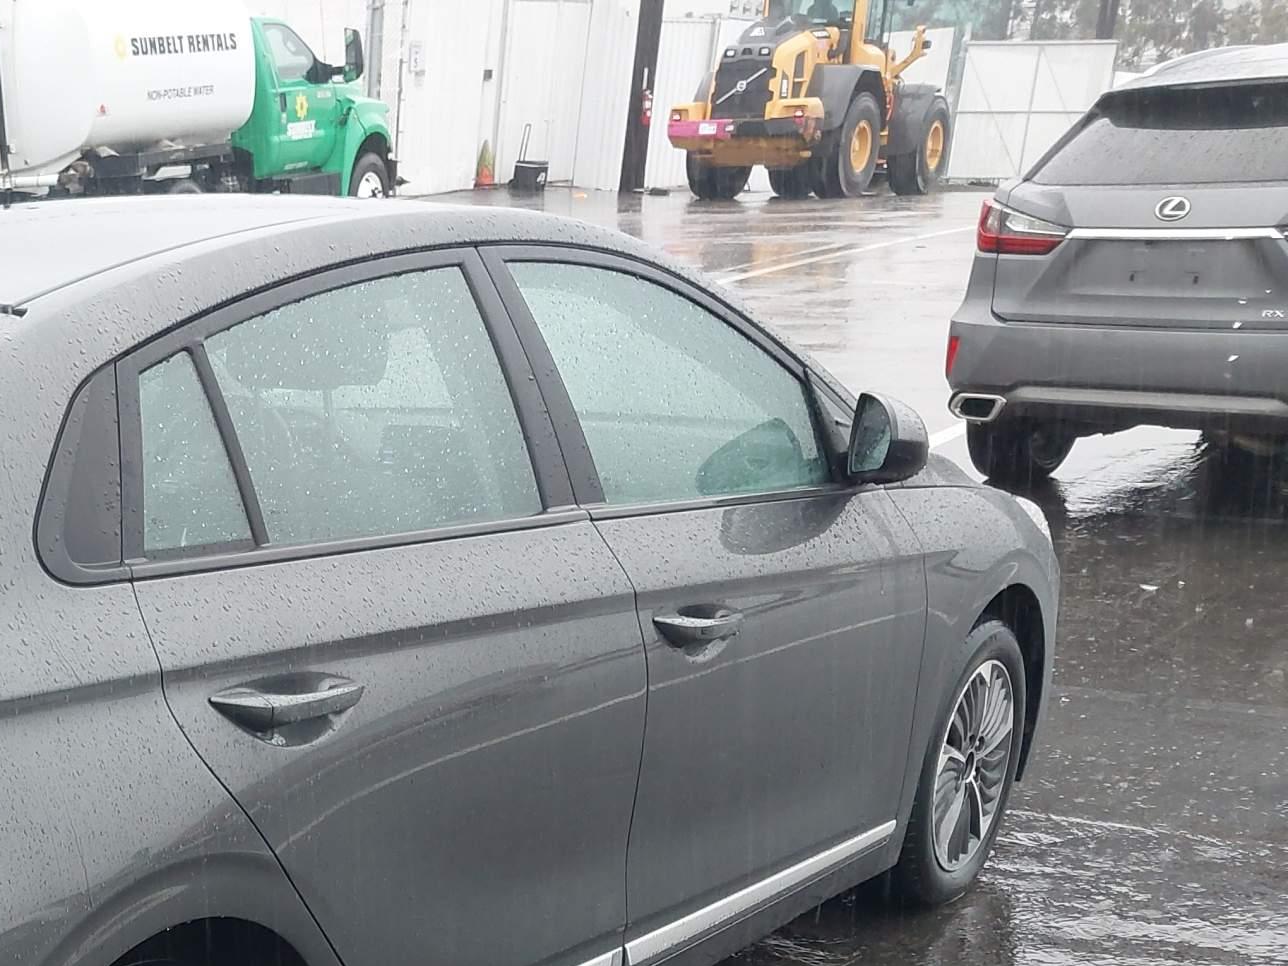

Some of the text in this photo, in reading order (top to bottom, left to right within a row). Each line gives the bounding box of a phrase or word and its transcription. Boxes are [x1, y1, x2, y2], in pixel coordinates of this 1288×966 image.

[130, 33, 237, 56] SUNBELT RENTALS
[1262, 310, 1284, 318] RX
